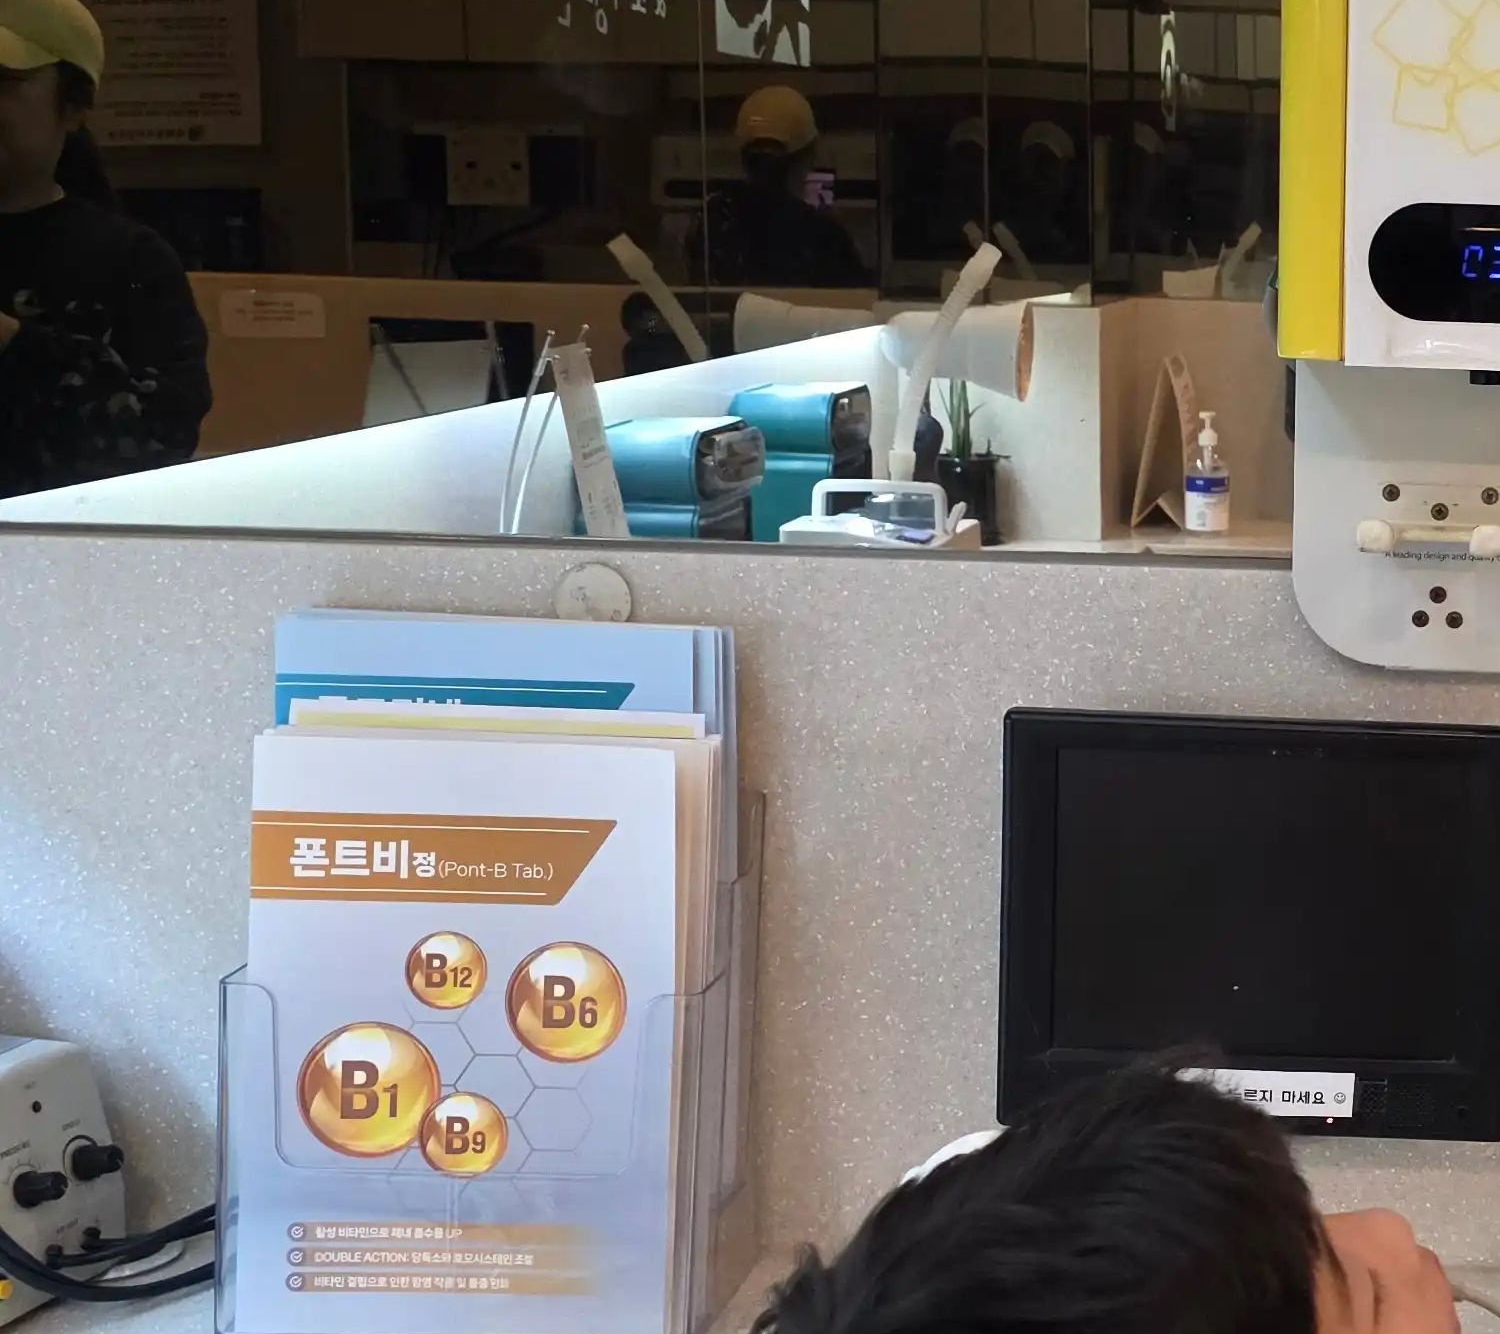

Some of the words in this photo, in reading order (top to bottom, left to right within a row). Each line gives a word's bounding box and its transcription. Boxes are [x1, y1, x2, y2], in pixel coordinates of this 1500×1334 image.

[290, 836, 437, 880] 폰트비정
[437, 859, 508, 880] (Pont-B
[514, 861, 555, 882] Tab.)
[424, 952, 473, 989] B12
[541, 974, 599, 1030] B6
[339, 1059, 399, 1121] B1
[1228, 1085, 1274, 1104] 르지
[1281, 1090, 1326, 1105] 마세요
[444, 1115, 487, 1156] B9
[314, 1251, 362, 1263] DOUBLE
[363, 1251, 410, 1264] ACTION:
[314, 1275, 345, 1288] 비타민
